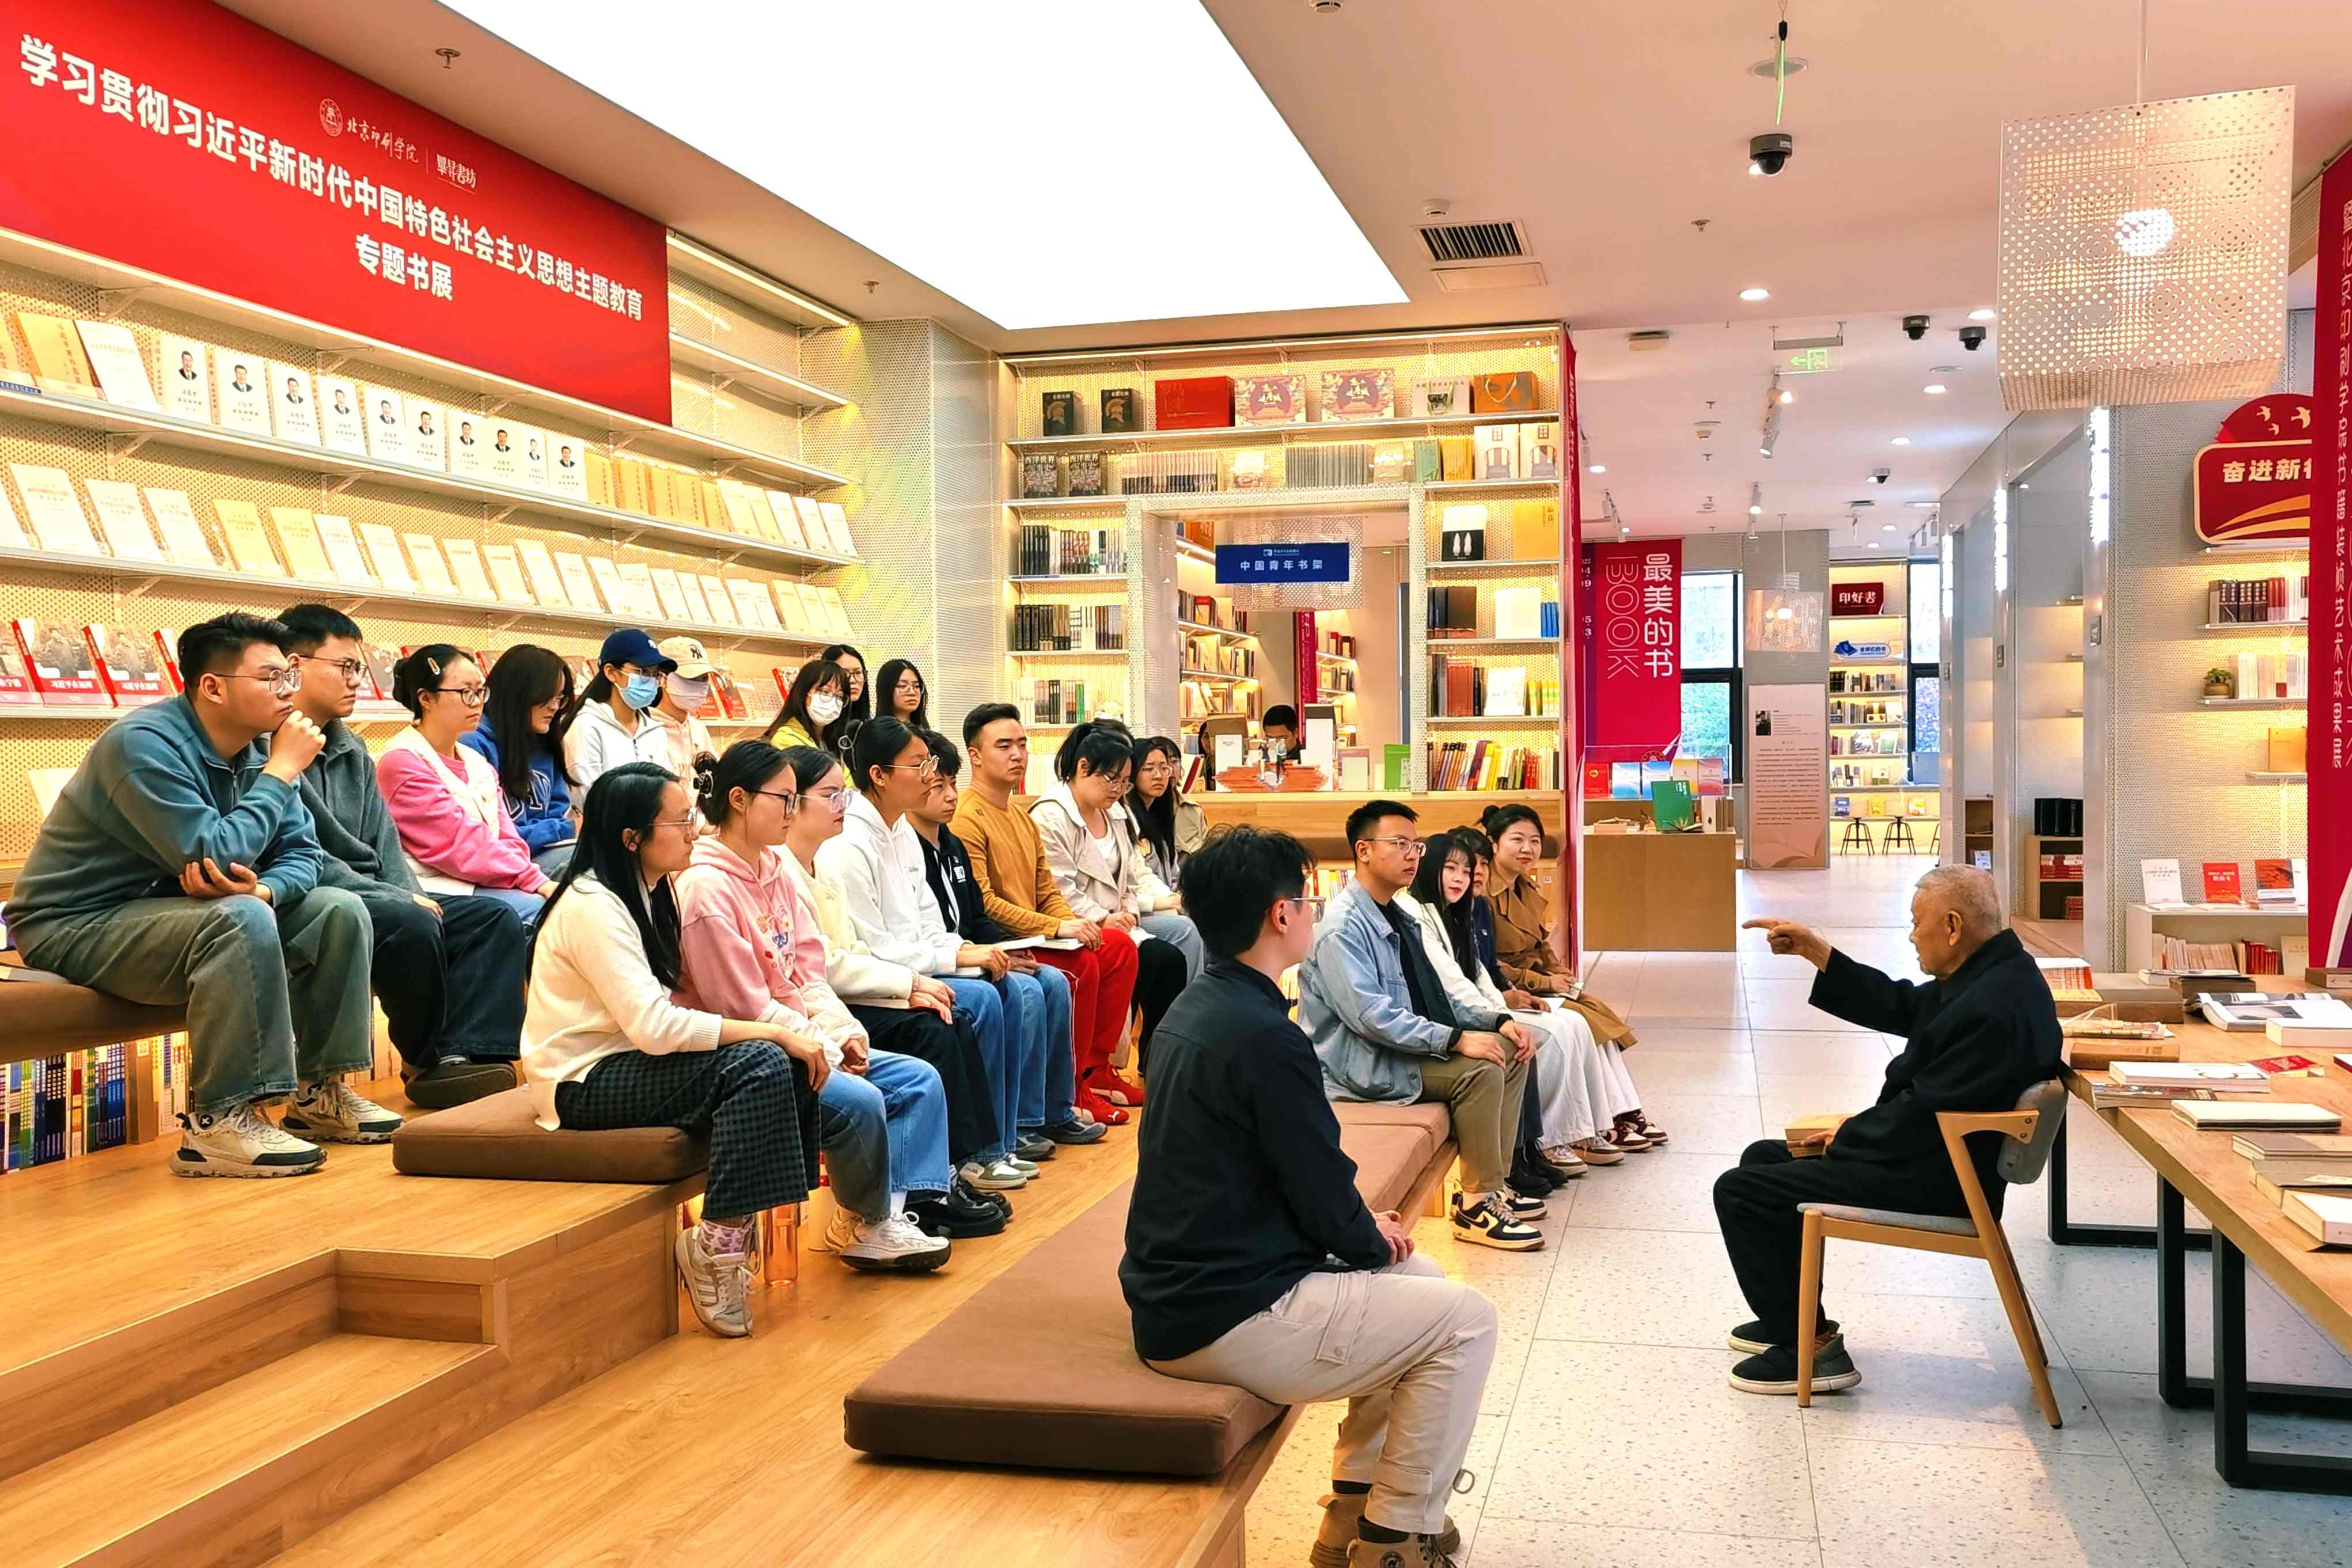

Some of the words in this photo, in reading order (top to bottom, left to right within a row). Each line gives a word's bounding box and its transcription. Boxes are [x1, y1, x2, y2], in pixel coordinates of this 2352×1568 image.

[21, 34, 642, 321] 学习贯彻习近平新时代中国特色社会主义思想主题教育
[347, 117, 419, 163] 北京印刷学院
[355, 233, 453, 301] 专题书展
[1241, 560, 1323, 571] 中国青年书架
[1606, 556, 1640, 679] BOOK
[1643, 553, 1674, 678] 最美的书
